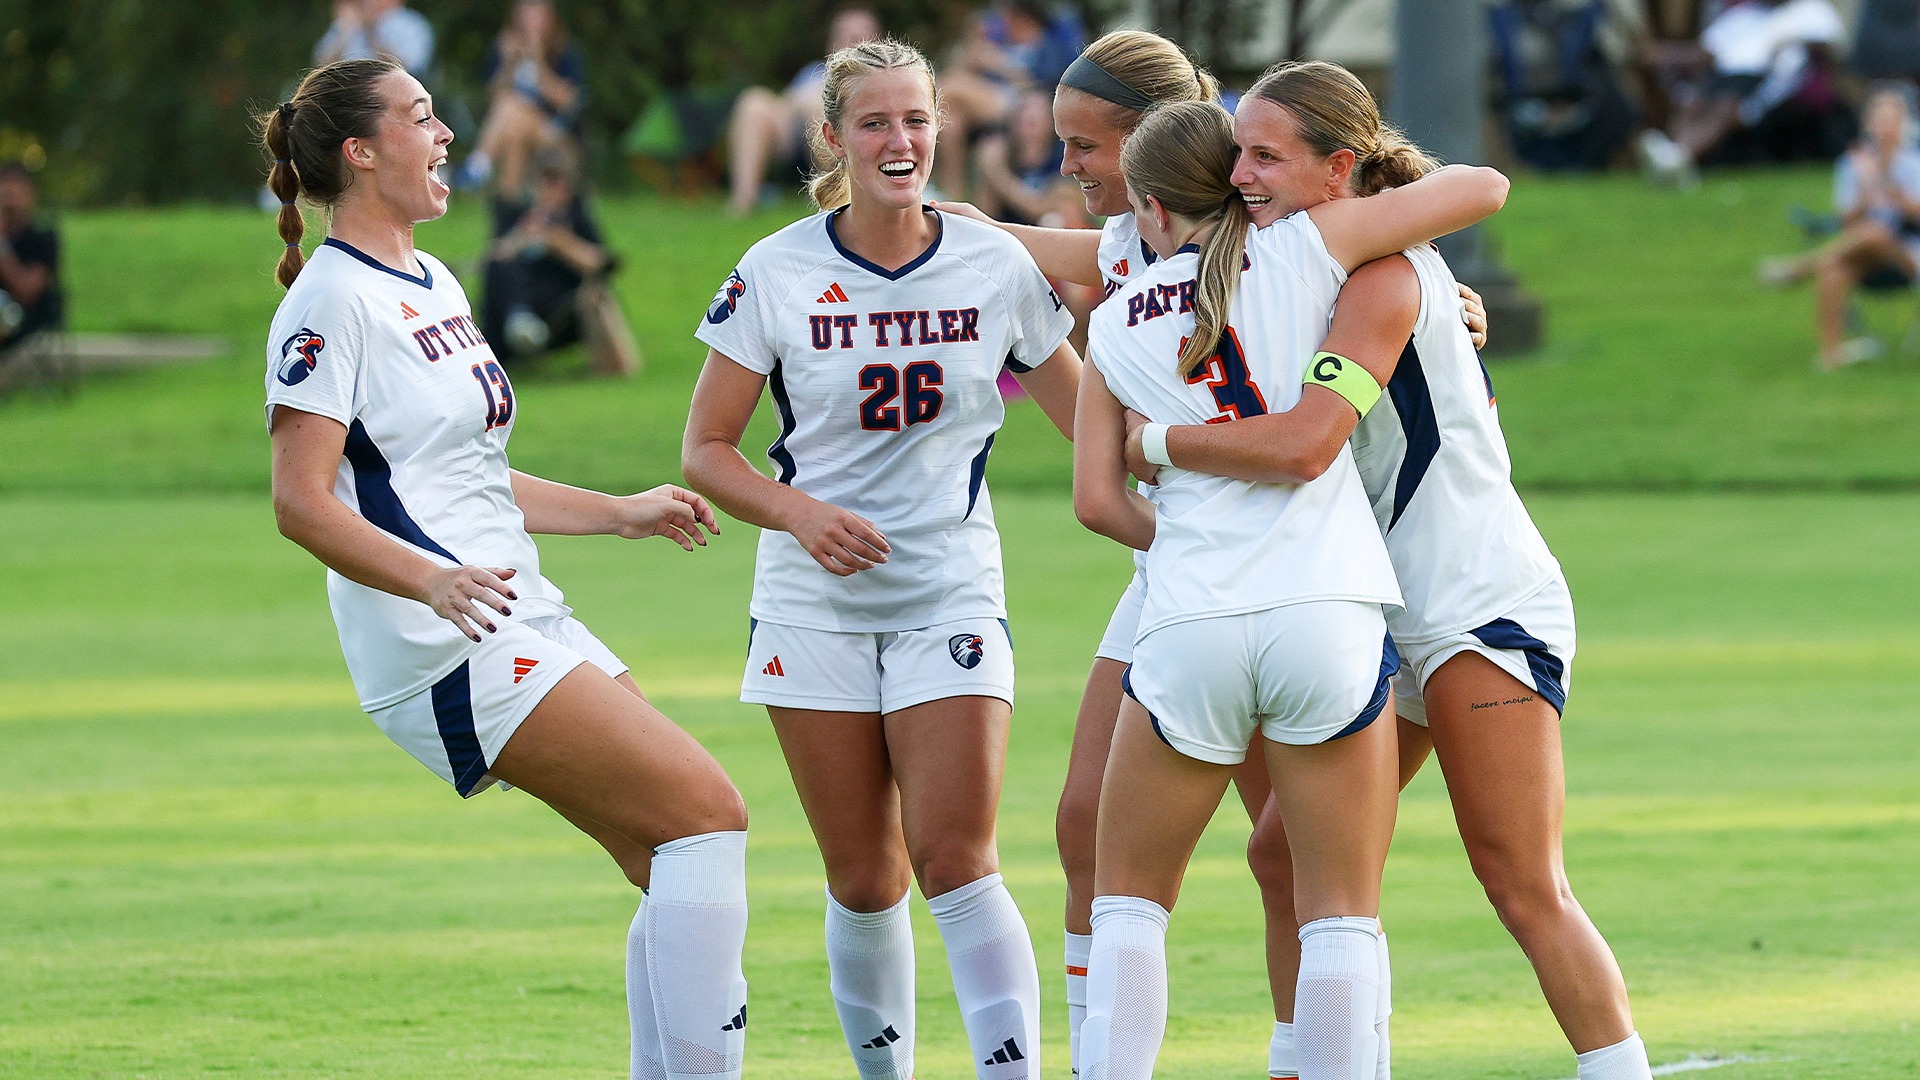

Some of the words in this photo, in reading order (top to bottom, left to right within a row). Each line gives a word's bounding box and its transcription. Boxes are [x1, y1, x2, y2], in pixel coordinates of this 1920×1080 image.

[412, 324, 454, 363] UT
[440, 314, 489, 351] TYL
[808, 314, 858, 351] UT
[868, 307, 980, 348] TYLER
[1176, 324, 1269, 425] 3
[1312, 355, 1343, 382] C
[470, 359, 513, 433] 13
[858, 360, 944, 432] 26
[1470, 700, 1500, 713] facere
